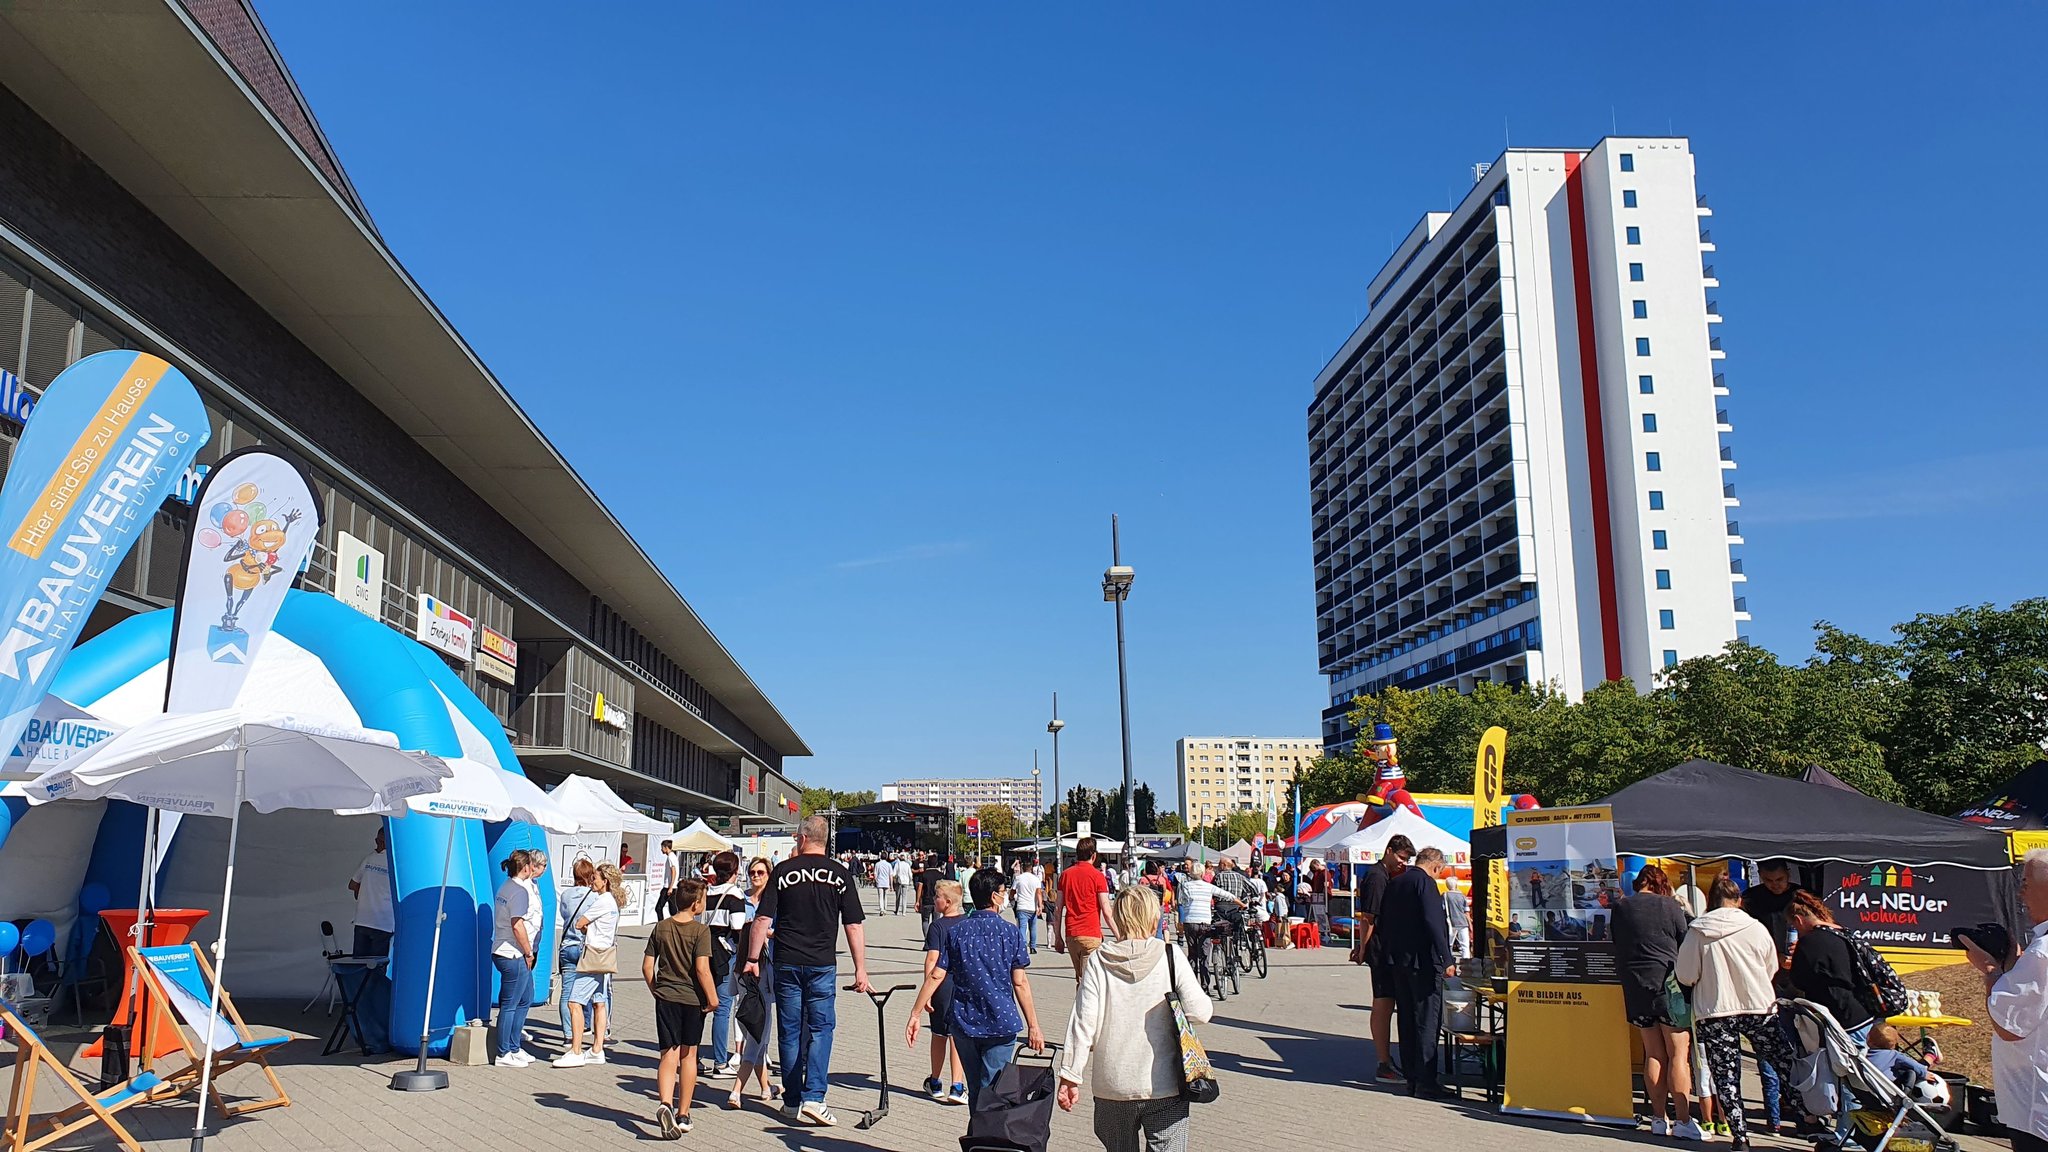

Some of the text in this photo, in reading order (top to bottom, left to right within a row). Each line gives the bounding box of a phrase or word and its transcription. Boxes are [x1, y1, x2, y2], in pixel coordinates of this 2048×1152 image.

[21, 376, 151, 548] Hier sind Sie zu Hause.
[17, 412, 176, 632] BAUVEREIN
[48, 566, 104, 640] HALLE
[102, 544, 119, 557] &
[115, 464, 166, 535] LEUNA
[451, 627, 468, 653] family
[28, 719, 114, 748] BAUVERE
[26, 747, 59, 760] HALLE
[439, 802, 488, 814] BAUVEREIN
[1494, 885, 1504, 922] BAUEN
[1840, 892, 1948, 912] HA-NEUer
[1860, 906, 1918, 924] wohnen
[1852, 930, 1926, 942] GANISIEREN
[1517, 990, 1582, 1000] WIR BILDEN AUS
